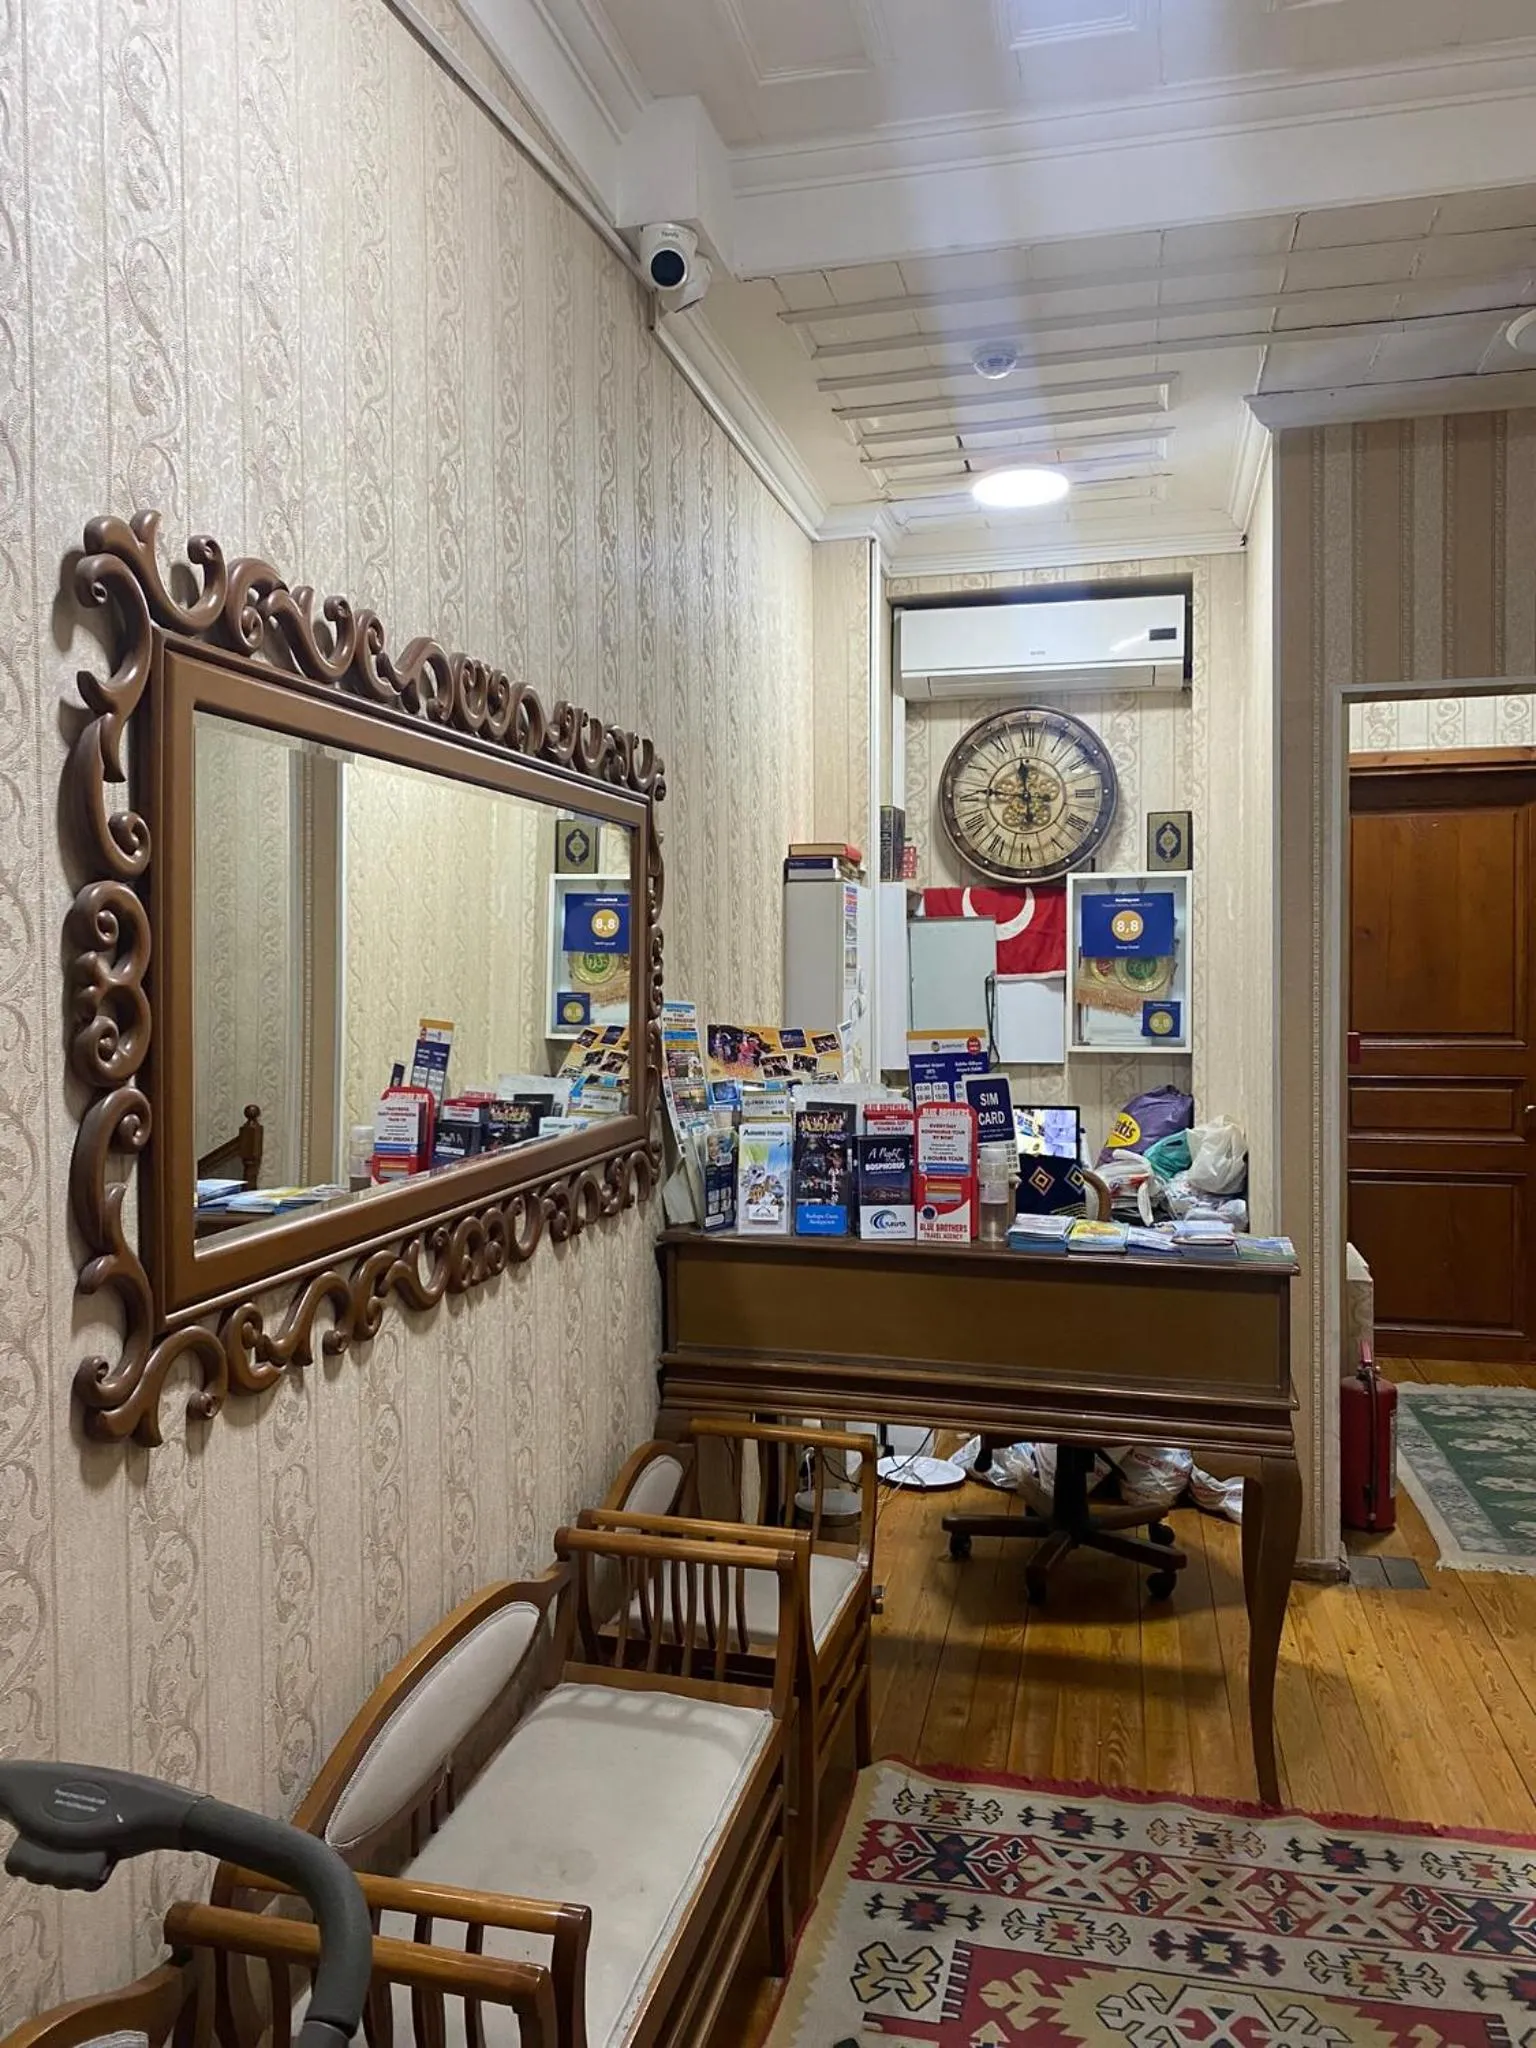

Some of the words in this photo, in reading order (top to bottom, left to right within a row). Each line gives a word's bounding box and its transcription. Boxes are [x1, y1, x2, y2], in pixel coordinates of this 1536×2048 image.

[1116, 920, 1139, 934] 8,8
[980, 1092, 999, 1107] SIM
[978, 1111, 1005, 1126] CARD
[865, 1161, 906, 1172] BOSPHORUS
[920, 1223, 935, 1232] BLUE
[936, 1222, 968, 1233] BROTHERS
